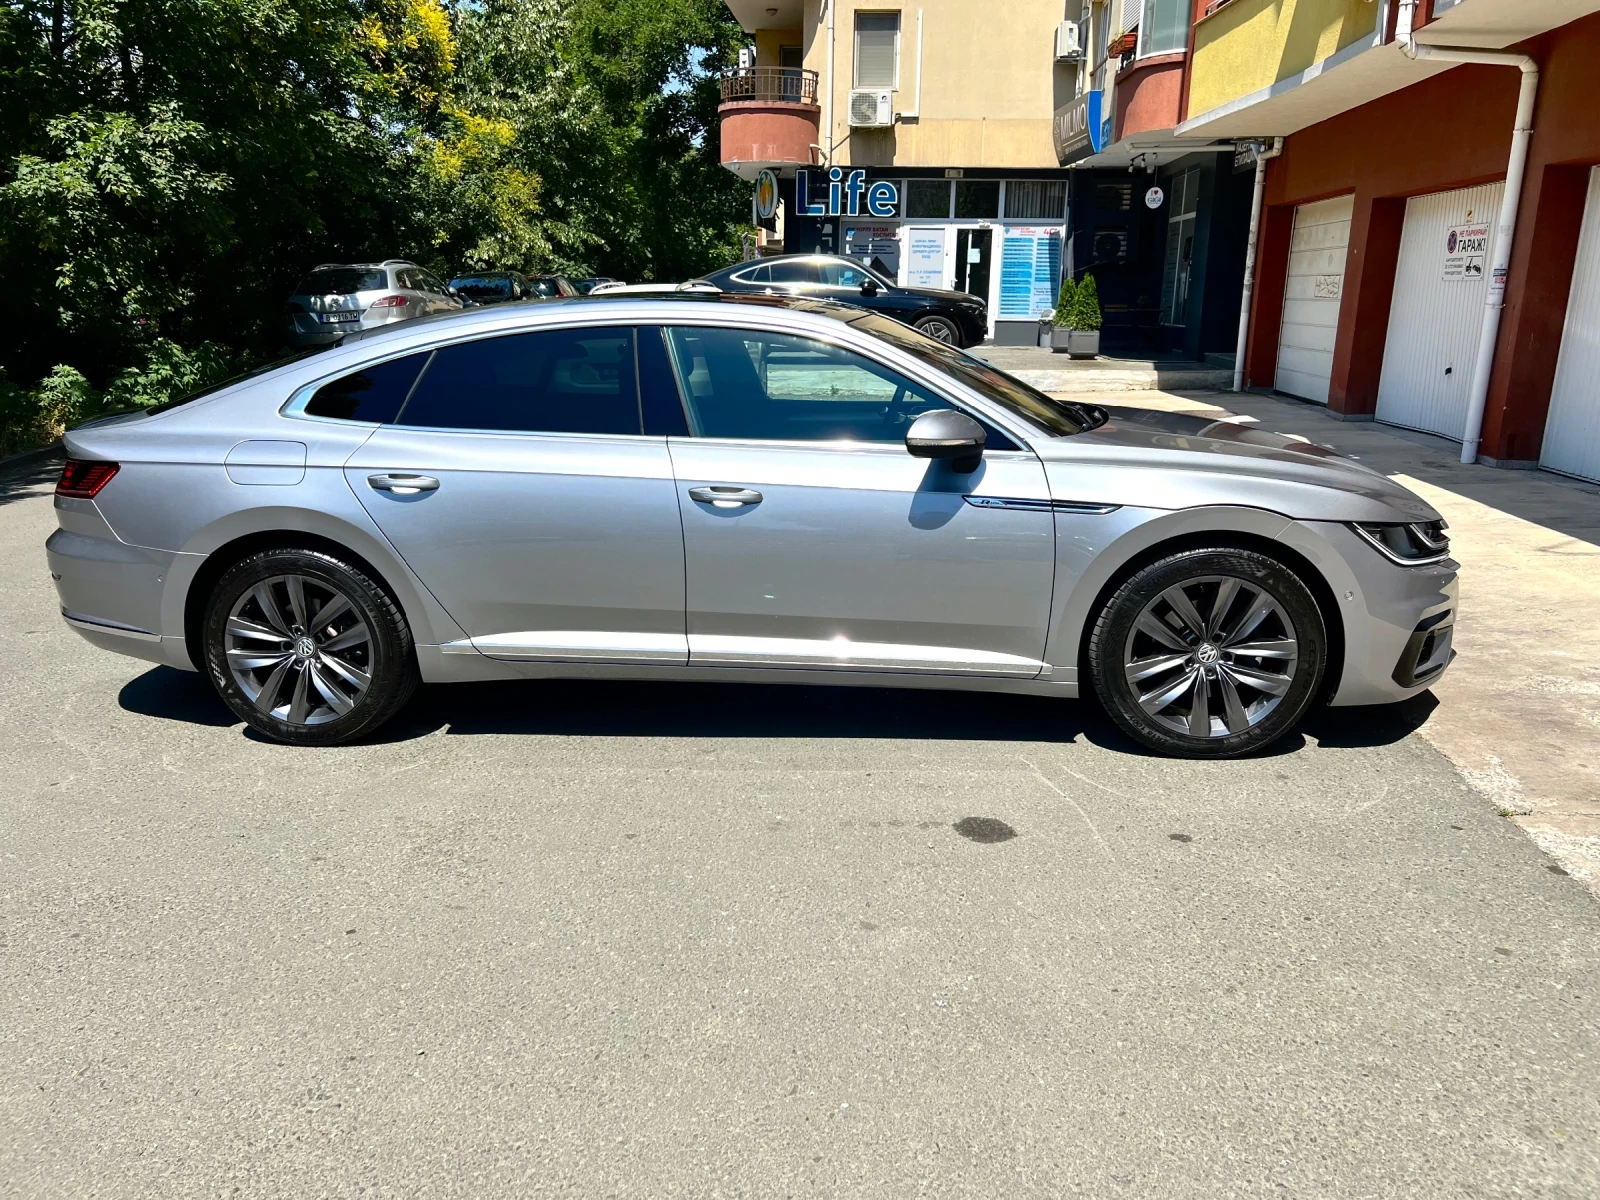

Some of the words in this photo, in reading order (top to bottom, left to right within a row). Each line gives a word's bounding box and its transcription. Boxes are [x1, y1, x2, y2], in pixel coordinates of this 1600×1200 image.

[1061, 103, 1086, 140] MILMO
[796, 167, 898, 217] Life
[1458, 238, 1486, 252] ГАРАЖ!
